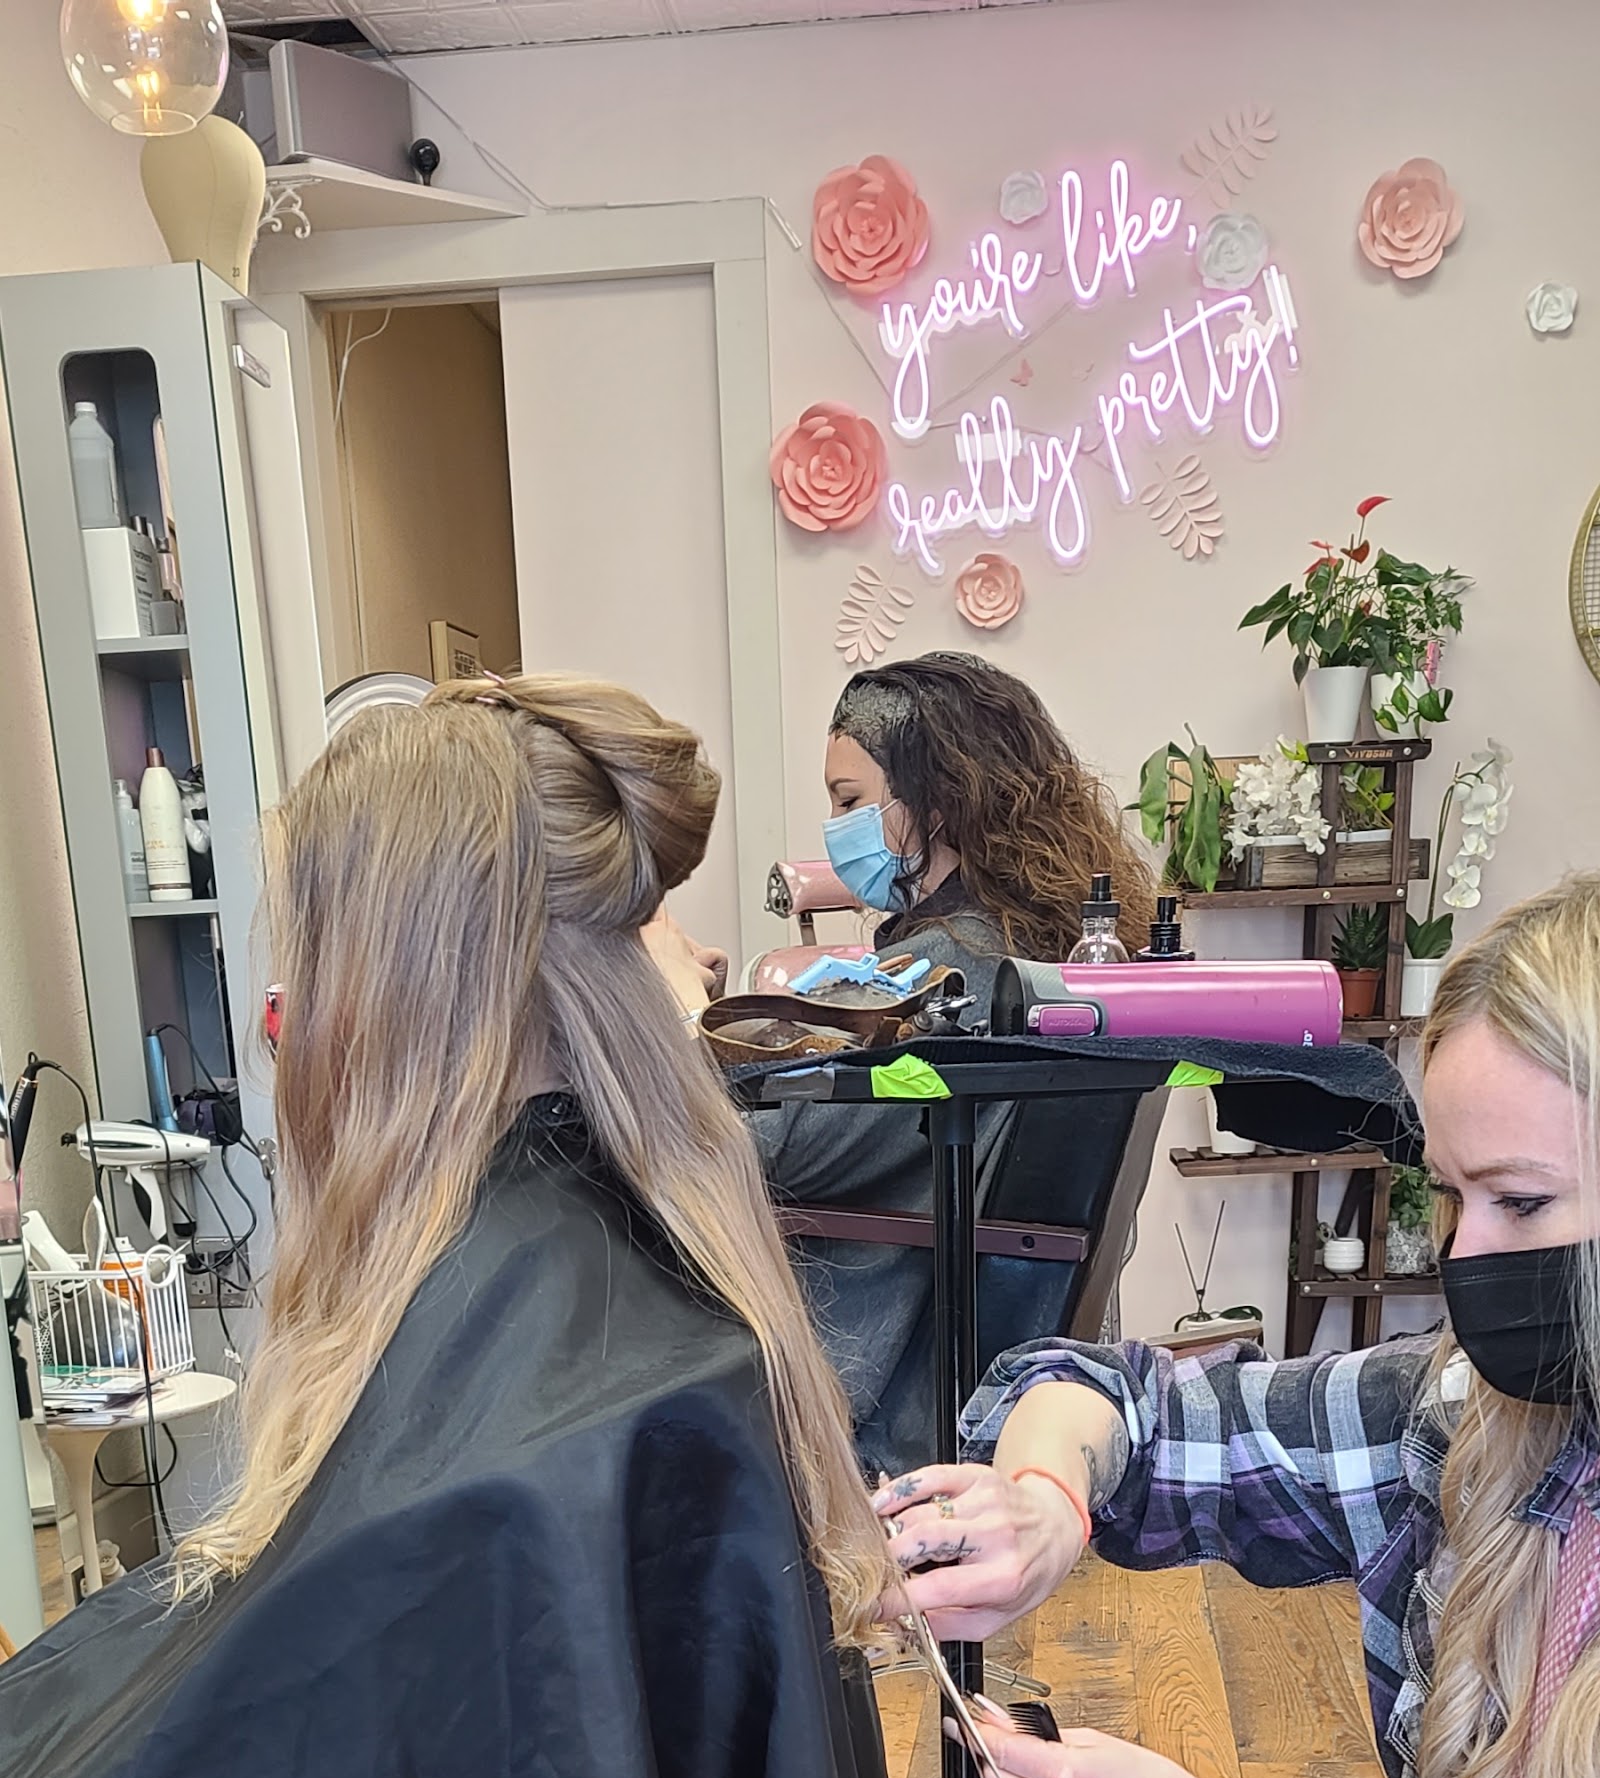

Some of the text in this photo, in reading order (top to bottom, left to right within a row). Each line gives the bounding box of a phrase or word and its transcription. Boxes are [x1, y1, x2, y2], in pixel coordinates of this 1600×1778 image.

[882, 160, 1199, 430] you're like,
[888, 265, 1299, 570] really pretty!
